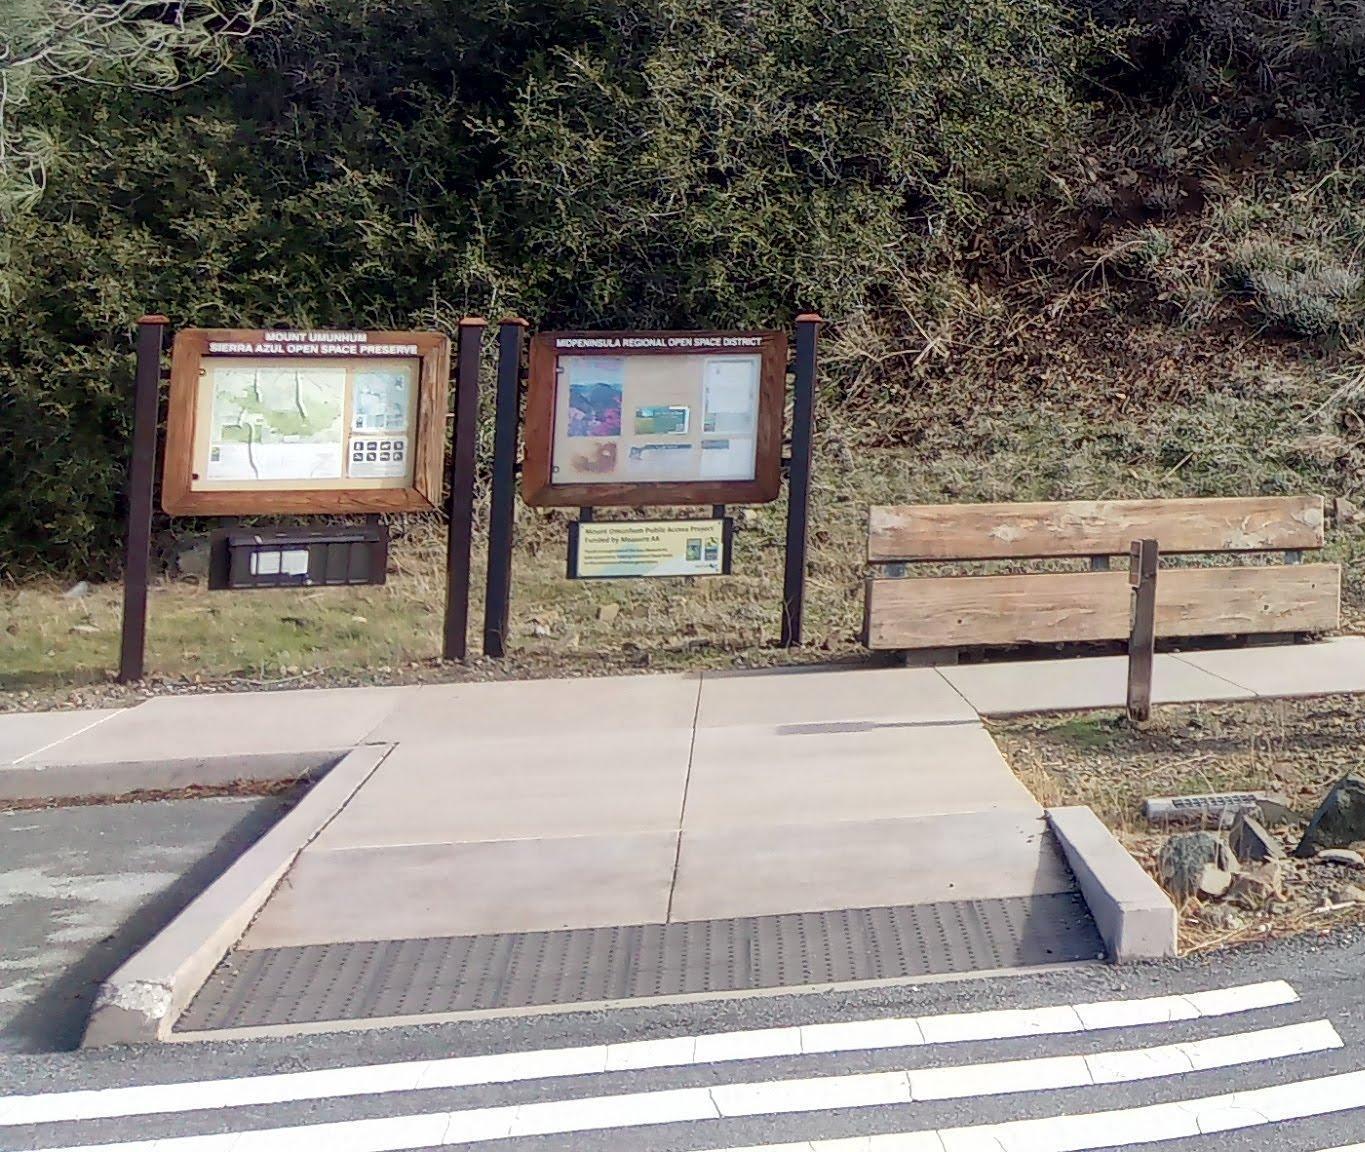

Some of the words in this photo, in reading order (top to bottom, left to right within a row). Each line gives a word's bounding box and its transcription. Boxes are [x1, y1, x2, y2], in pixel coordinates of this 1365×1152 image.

[265, 332, 306, 342] MOUNT
[309, 332, 368, 343] UMUNHUM
[556, 338, 621, 348] MIDPENINSULA
[622, 338, 668, 347] REGIONAL
[668, 338, 693, 347] OPEN
[694, 337, 722, 346] SPACE
[723, 337, 762, 346] DISTRICT
[209, 342, 253, 353] SIERRA
[255, 343, 285, 353] AZUL
[287, 344, 319, 354] OPEN
[321, 344, 357, 354] SPACE
[359, 345, 418, 355] PRESERVE
